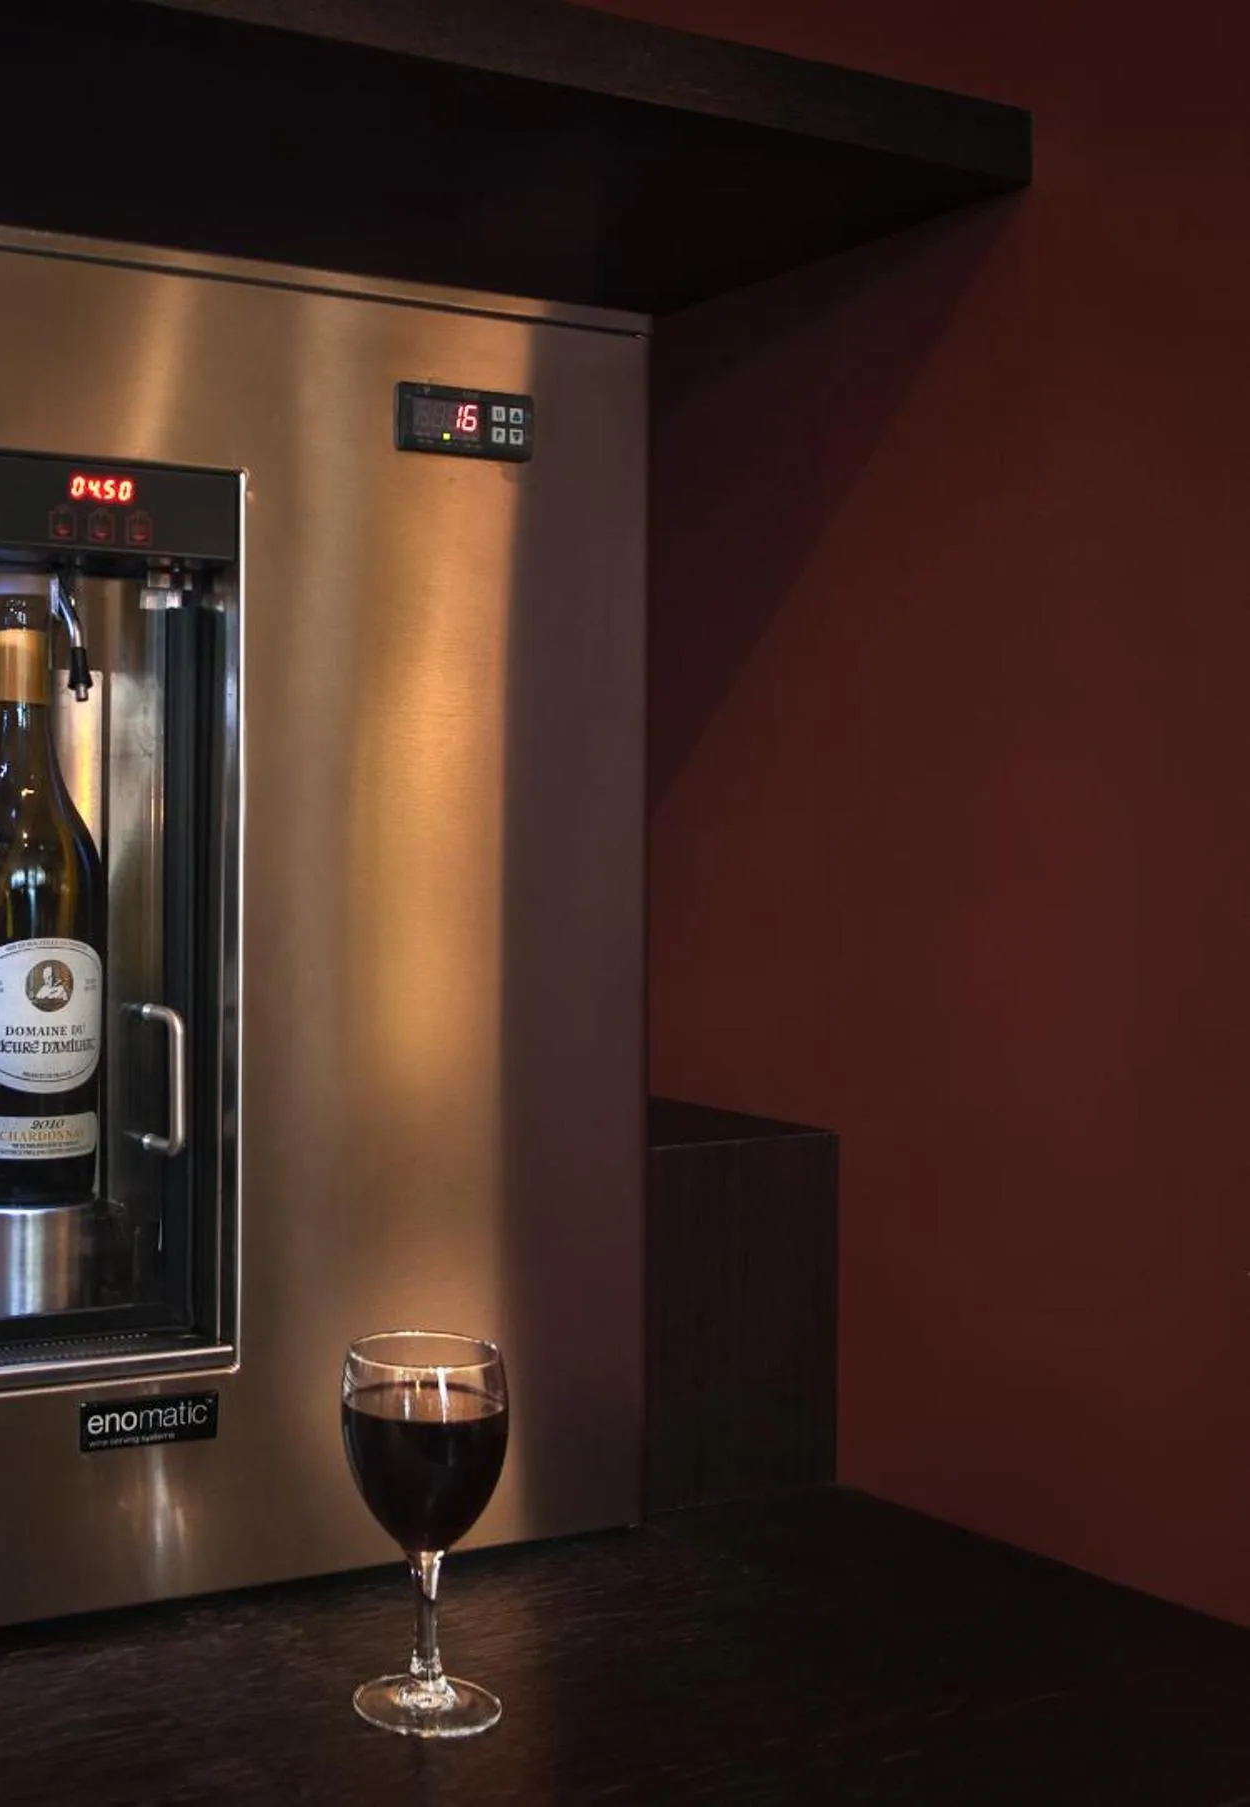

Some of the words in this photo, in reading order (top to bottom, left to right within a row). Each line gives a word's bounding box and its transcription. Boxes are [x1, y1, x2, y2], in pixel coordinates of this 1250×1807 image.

[456, 404, 478, 431] 16
[4, 1025, 67, 1036] DOMAINE
[87, 1401, 208, 1434] enomatic
